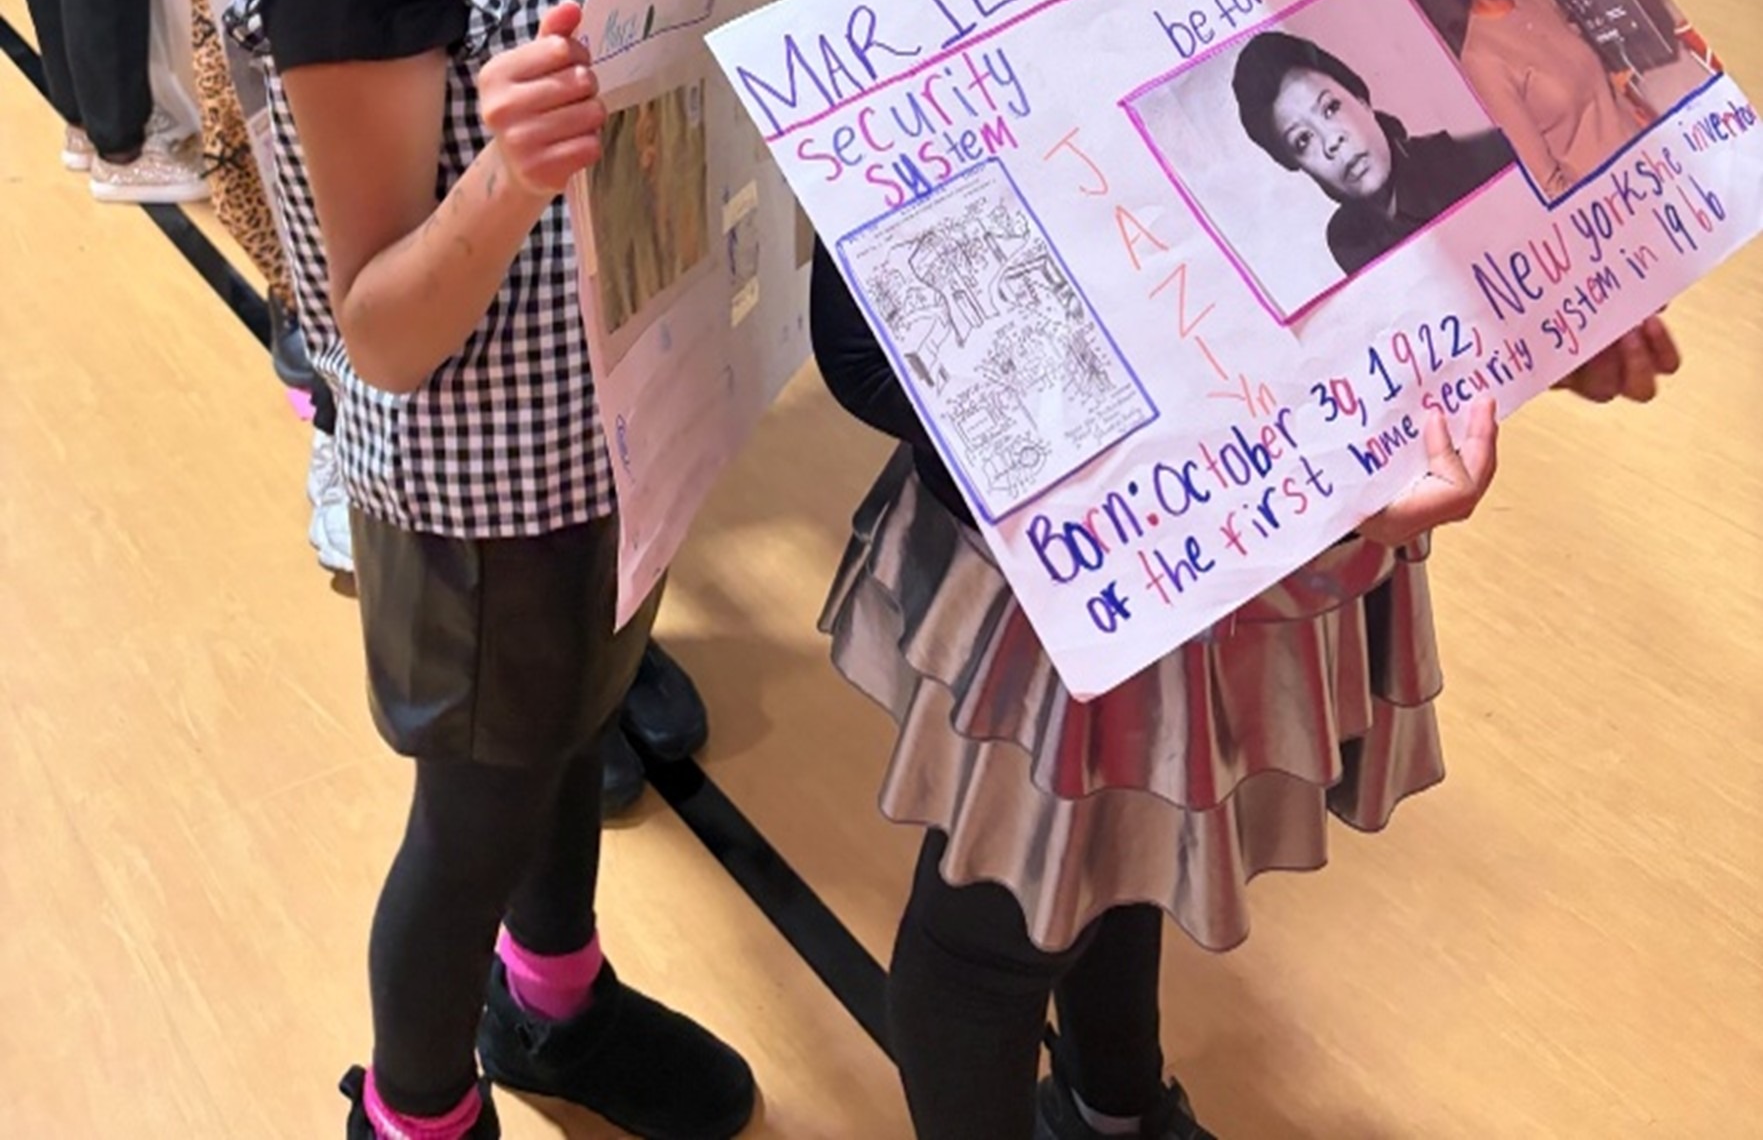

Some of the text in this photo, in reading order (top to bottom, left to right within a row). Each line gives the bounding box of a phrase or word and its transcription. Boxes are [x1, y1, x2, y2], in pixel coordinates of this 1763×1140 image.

[797, 47, 1031, 181] security
[1137, 536, 1216, 606] the
[1219, 457, 1334, 557] first
[1348, 413, 1420, 476] home
[1422, 339, 1533, 415] security
[1540, 264, 1622, 355] system
[1623, 244, 1659, 280] in
[1652, 175, 1728, 256] 1966
[1152, 407, 1298, 519] October
[1310, 376, 1368, 427] 30,
[1472, 222, 1571, 321] New
